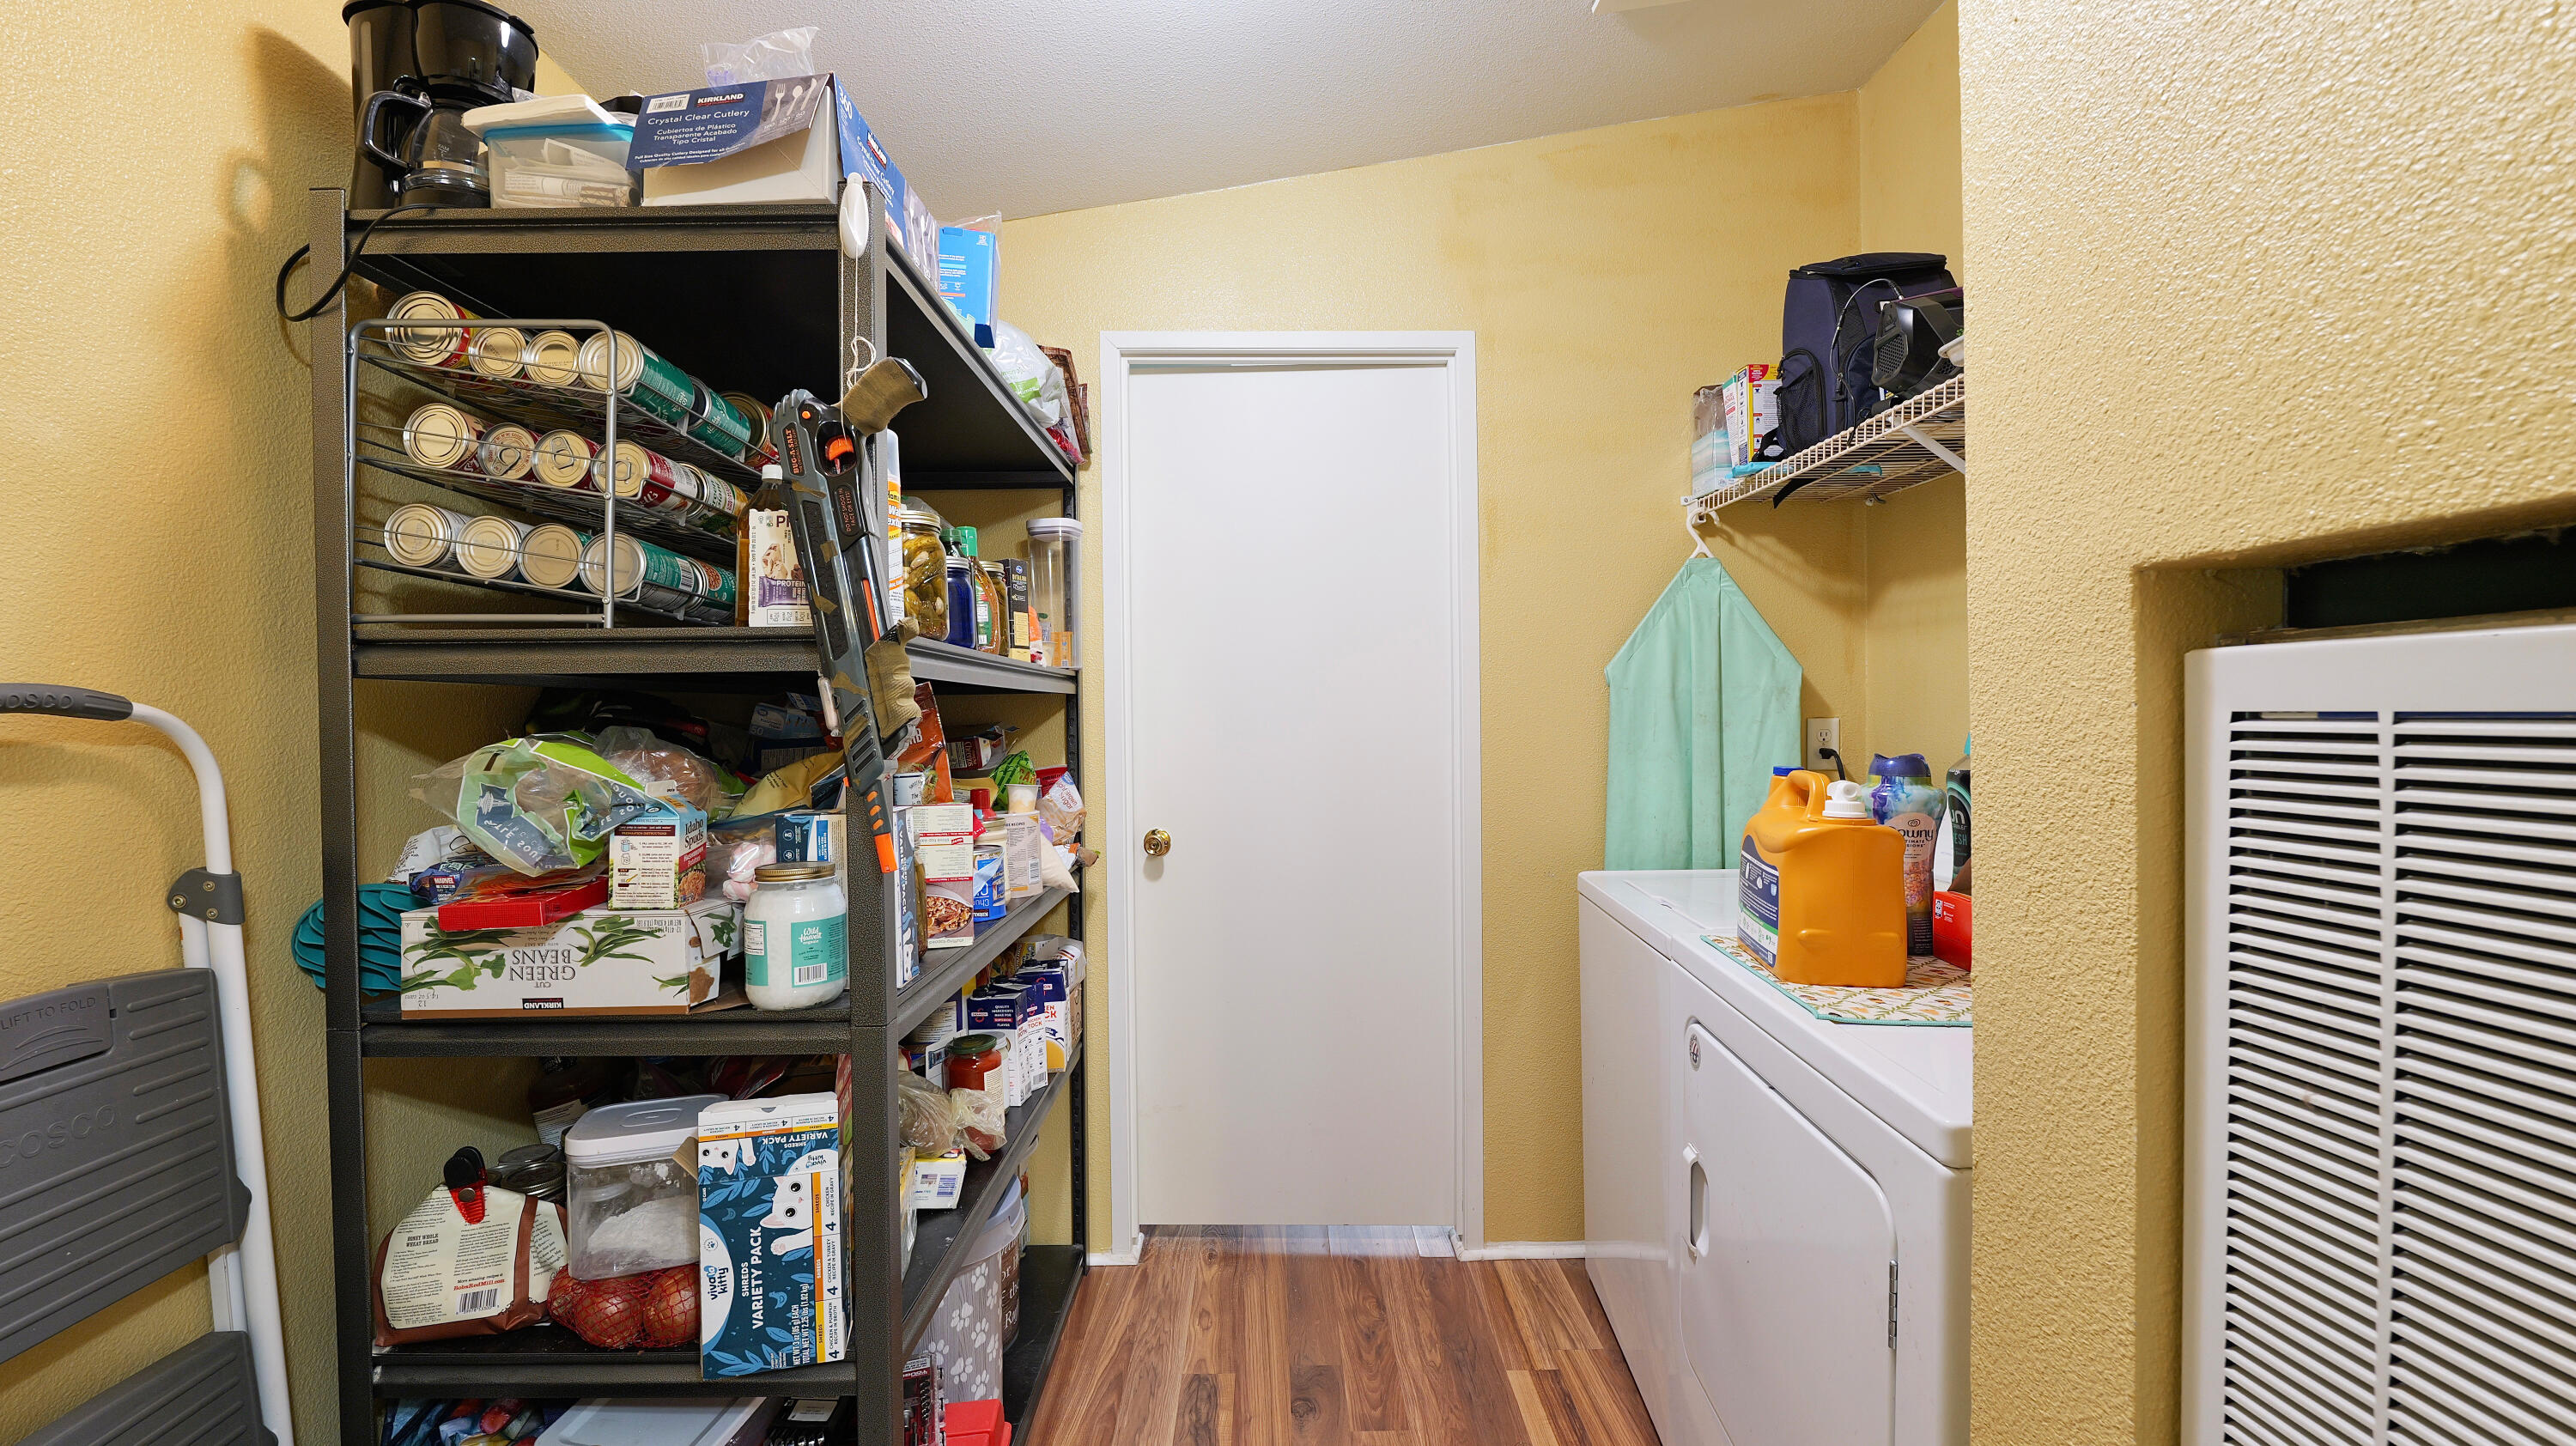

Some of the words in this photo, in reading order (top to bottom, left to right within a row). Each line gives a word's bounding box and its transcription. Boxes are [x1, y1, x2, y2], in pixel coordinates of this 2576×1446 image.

[697, 93, 744, 104] KIRKLAND
[839, 85, 853, 119] 360
[647, 116, 682, 125] Crystal
[685, 112, 711, 121] Clear
[714, 109, 750, 118] Cutlery
[653, 131, 702, 141] Transparente
[880, 173, 895, 195] Cutlery
[964, 742, 974, 767] Cheerios
[685, 817, 704, 835] Idaho
[684, 829, 704, 850] Spuds
[804, 927, 819, 936] Wild
[799, 933, 823, 943] Harvest
[512, 950, 572, 965] BEANS
[509, 965, 576, 982] GREEN
[524, 1001, 563, 1010] KIRKLAND
[1, 1012, 33, 1030] LIFT
[35, 1006, 55, 1019] TO
[59, 996, 96, 1013] FOLD
[1028, 1020, 1042, 1029] TOCK
[0, 1104, 116, 1169] COSCO
[762, 1135, 787, 1145] PACK
[788, 1132, 828, 1143] VARIETY
[825, 1221, 836, 1231] 4
[750, 1226, 762, 1264] PACK
[453, 1279, 506, 1291] BobsRedMill.com
[718, 1267, 728, 1294] kitty
[741, 1261, 750, 1297] SHREDS
[800, 1284, 809, 1292] kg)
[827, 1285, 838, 1296] 4
[751, 1266, 764, 1329] VARIETY
[800, 1293, 809, 1307] (1.02
[792, 1326, 800, 1334] (85
[802, 1328, 809, 1338] WT
[793, 1346, 800, 1355] WT
[829, 1350, 840, 1358] 4
